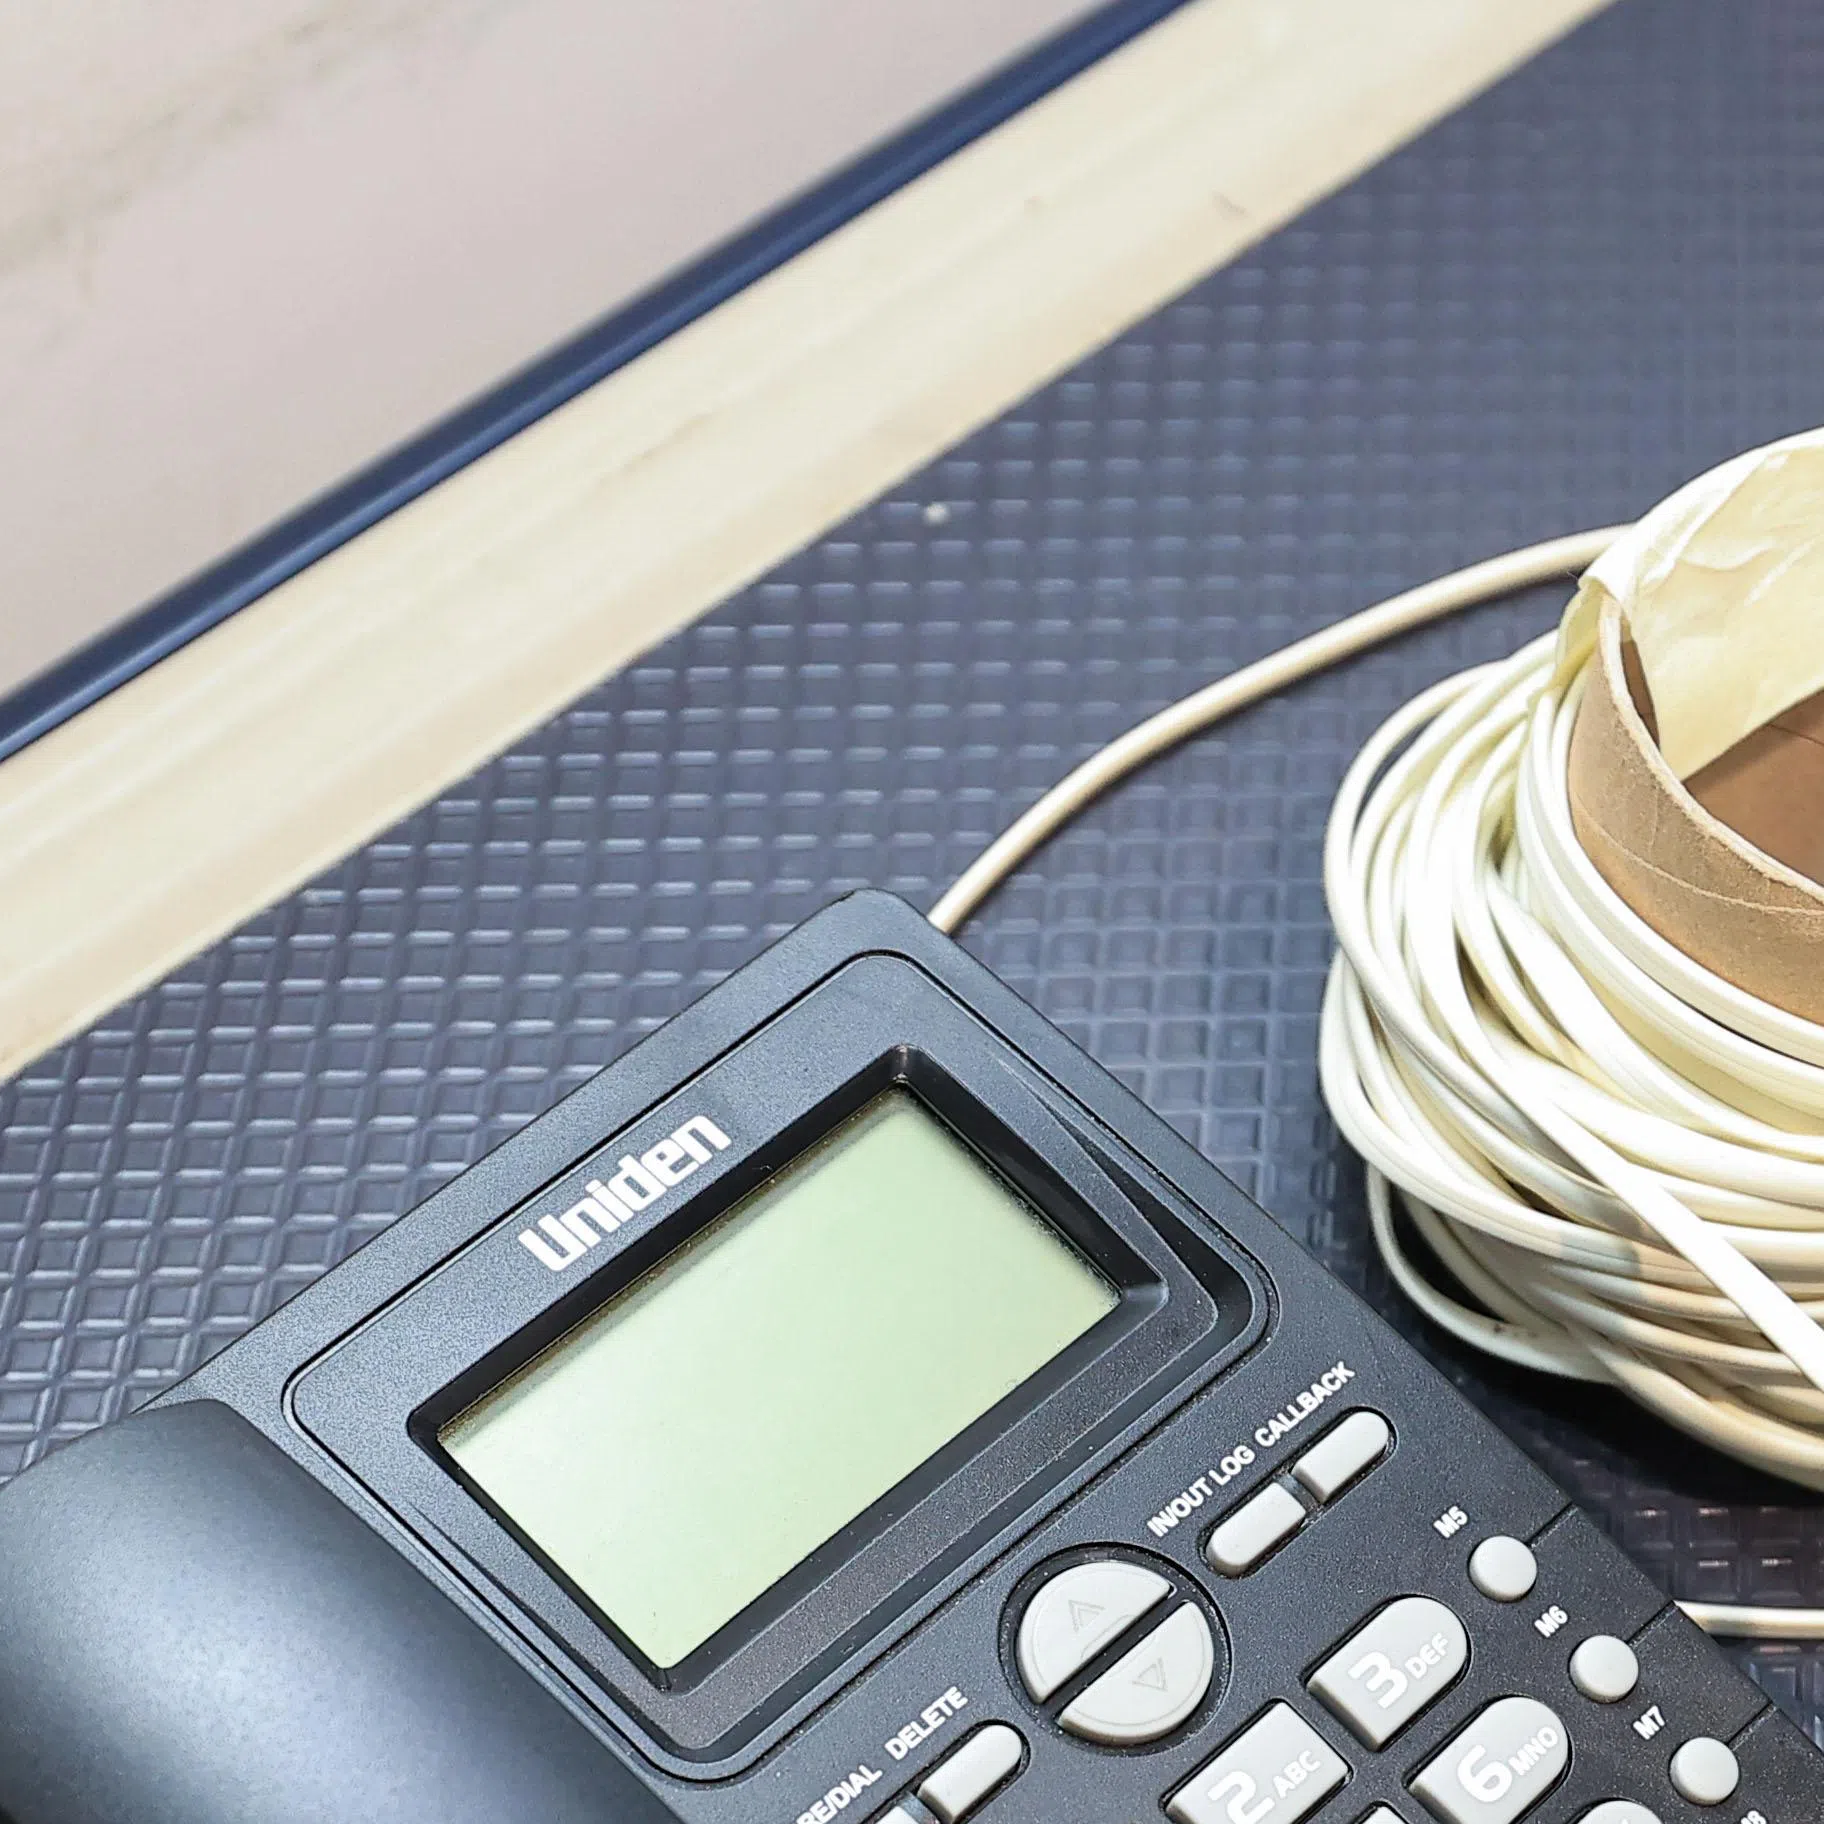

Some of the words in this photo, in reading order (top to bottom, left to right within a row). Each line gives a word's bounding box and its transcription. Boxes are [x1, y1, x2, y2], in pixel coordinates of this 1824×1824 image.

[516, 1114, 734, 1273] Uniden
[1146, 1474, 1213, 1538] IN/OUT
[1207, 1444, 1257, 1488] LOG
[1253, 1360, 1356, 1449] CALLBACK
[1432, 1504, 1470, 1540] M5
[1533, 1603, 1569, 1639] M6
[1348, 1649, 1409, 1709] 3
[1408, 1632, 1449, 1679] DEF
[884, 1685, 969, 1761] DELETE
[1631, 1704, 1667, 1742] M7
[1272, 1748, 1322, 1799] ABC
[1456, 1743, 1512, 1804] 6
[1507, 1725, 1560, 1777] MNO
